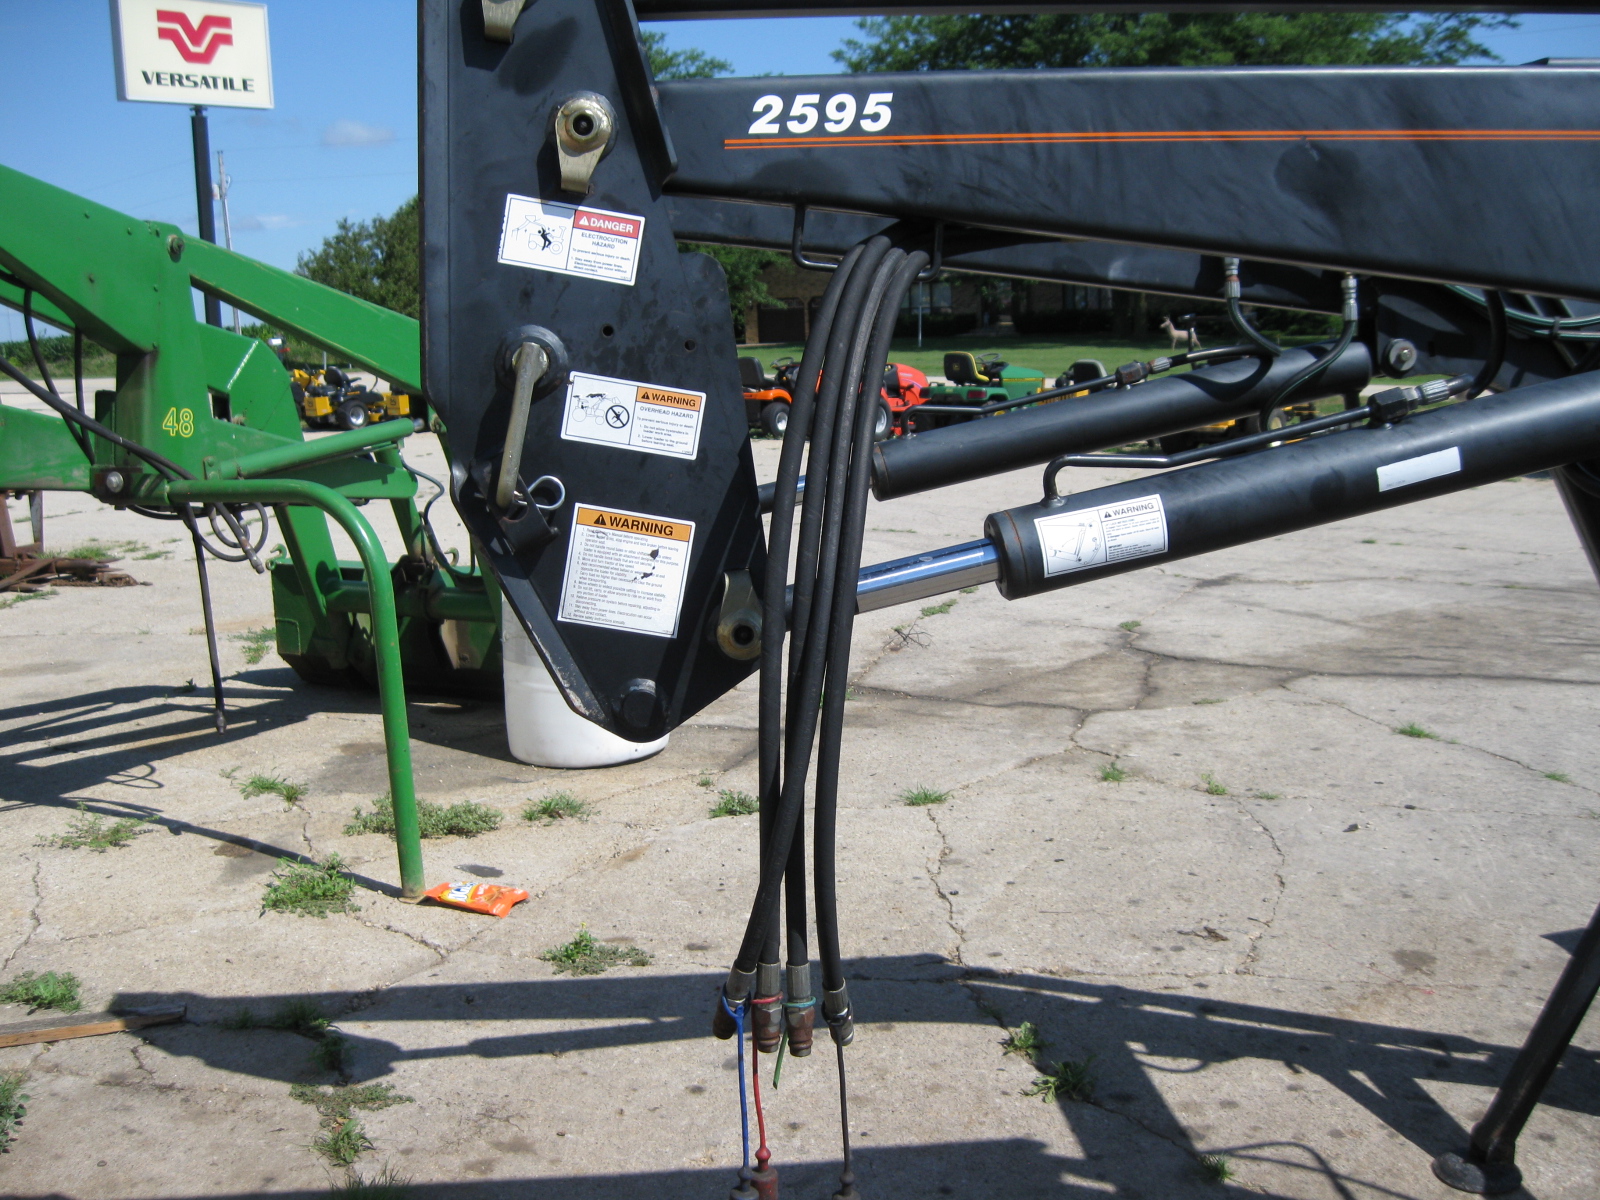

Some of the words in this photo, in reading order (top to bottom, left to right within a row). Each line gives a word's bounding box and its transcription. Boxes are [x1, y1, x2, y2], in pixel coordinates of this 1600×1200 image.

[141, 70, 255, 93] VERSATILE
[748, 92, 893, 134] 2595
[590, 218, 634, 234] DANGER
[581, 232, 628, 245] ELECTROCUTION
[592, 240, 615, 249] HAZARD
[651, 393, 696, 407] WARNING
[640, 406, 670, 415] OVERHEAD
[671, 411, 694, 419] HAZARD
[162, 406, 194, 438] 48
[1112, 503, 1154, 517] WARNING
[609, 515, 674, 537] WARNING
